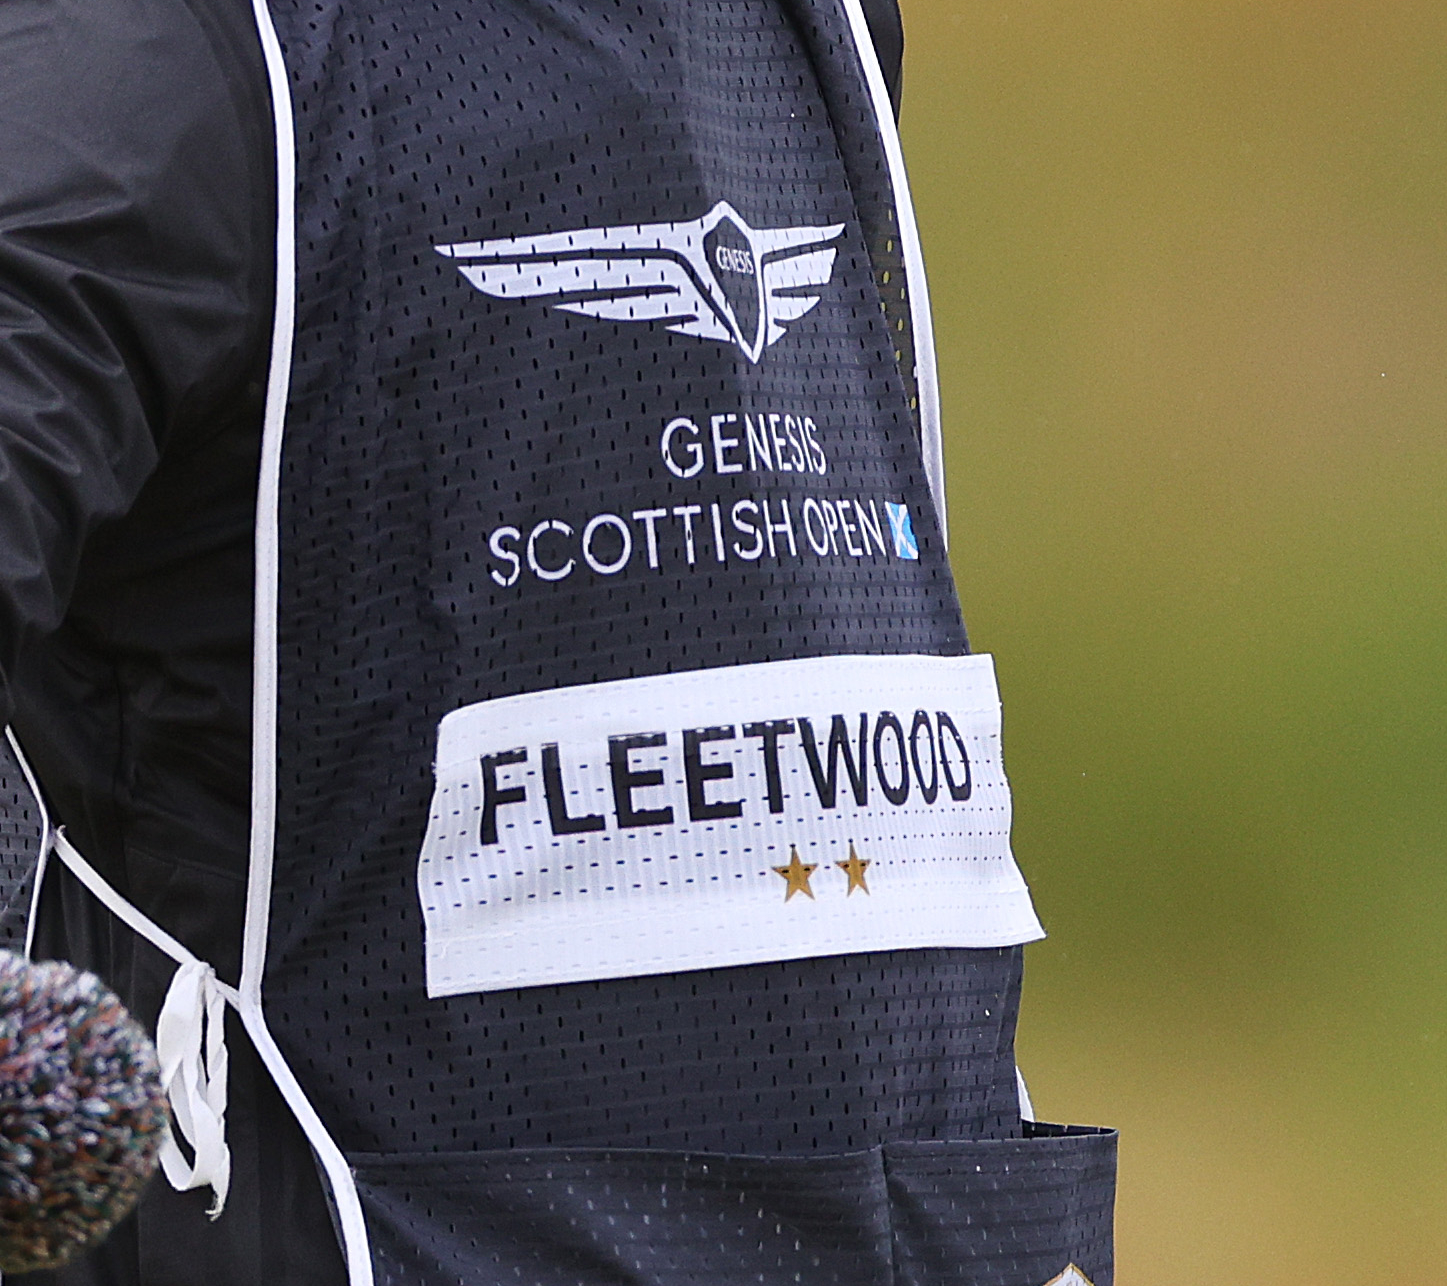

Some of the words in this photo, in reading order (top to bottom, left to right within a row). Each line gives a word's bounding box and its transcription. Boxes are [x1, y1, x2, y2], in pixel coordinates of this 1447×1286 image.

[660, 414, 827, 478] GENESIS
[488, 500, 797, 587] SCOTTISH
[807, 498, 885, 558] OPEN
[478, 710, 971, 846] FLEETWOOD
